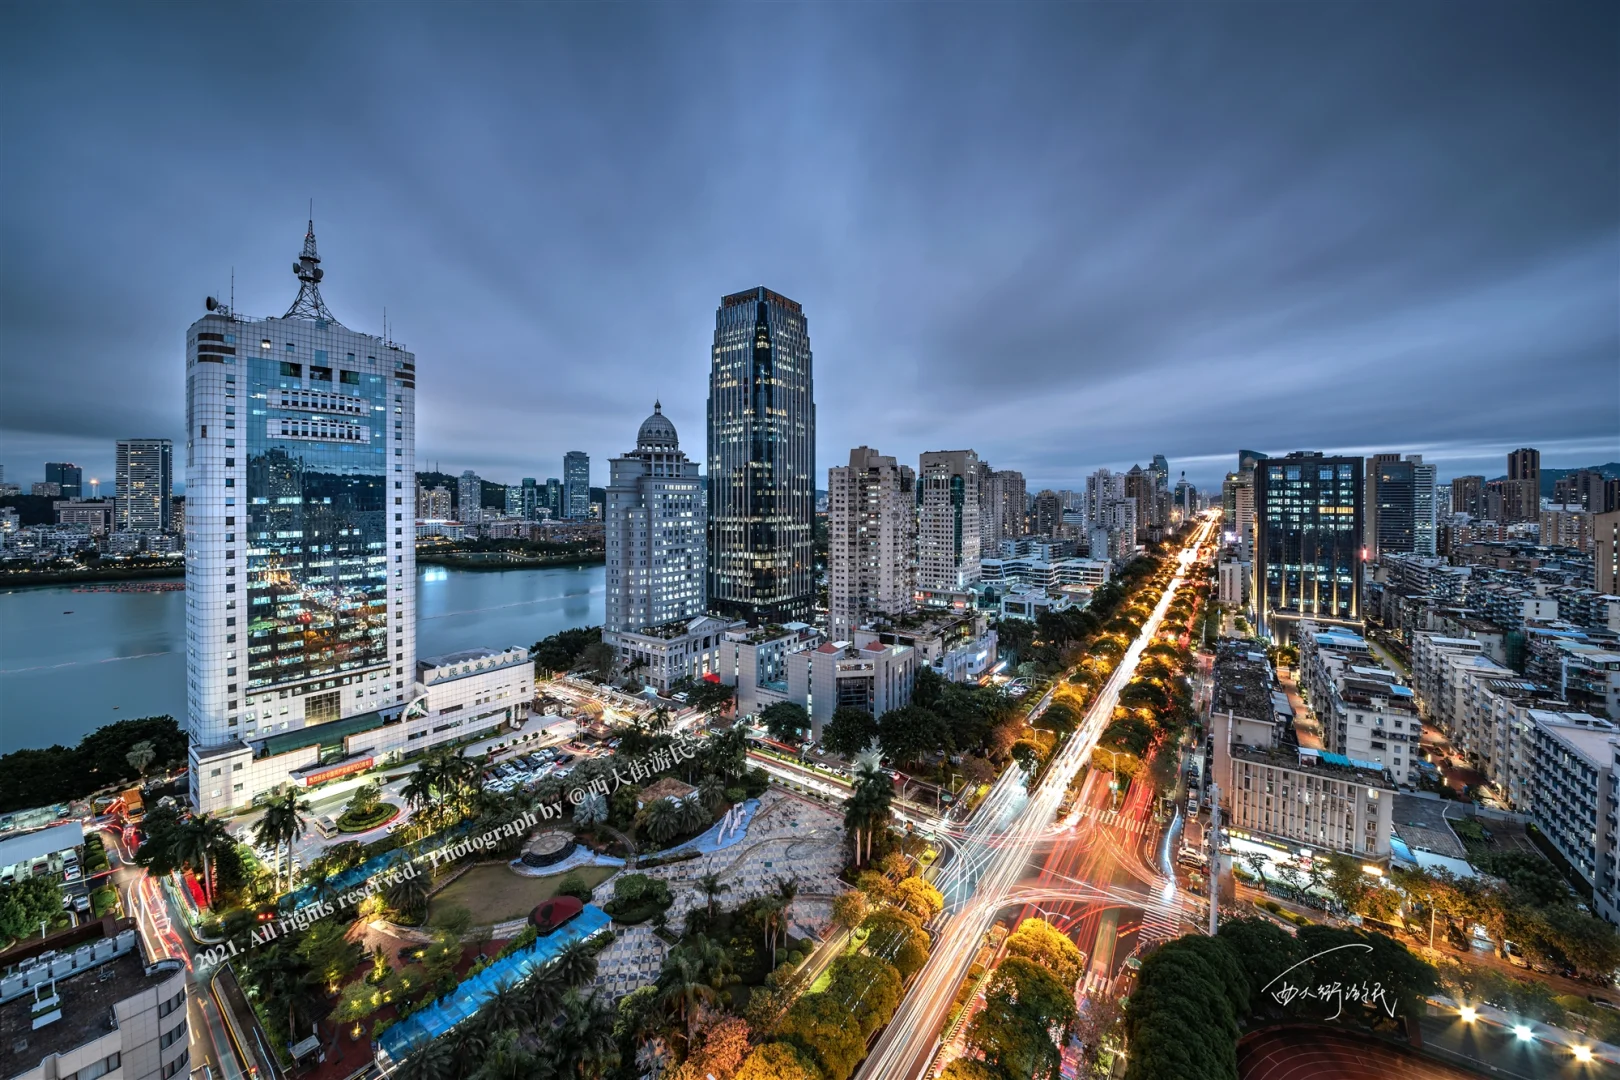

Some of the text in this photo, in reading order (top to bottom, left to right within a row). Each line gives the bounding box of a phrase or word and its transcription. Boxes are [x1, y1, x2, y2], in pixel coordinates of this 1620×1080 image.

[435, 654, 520, 680] 人民电业为人民
